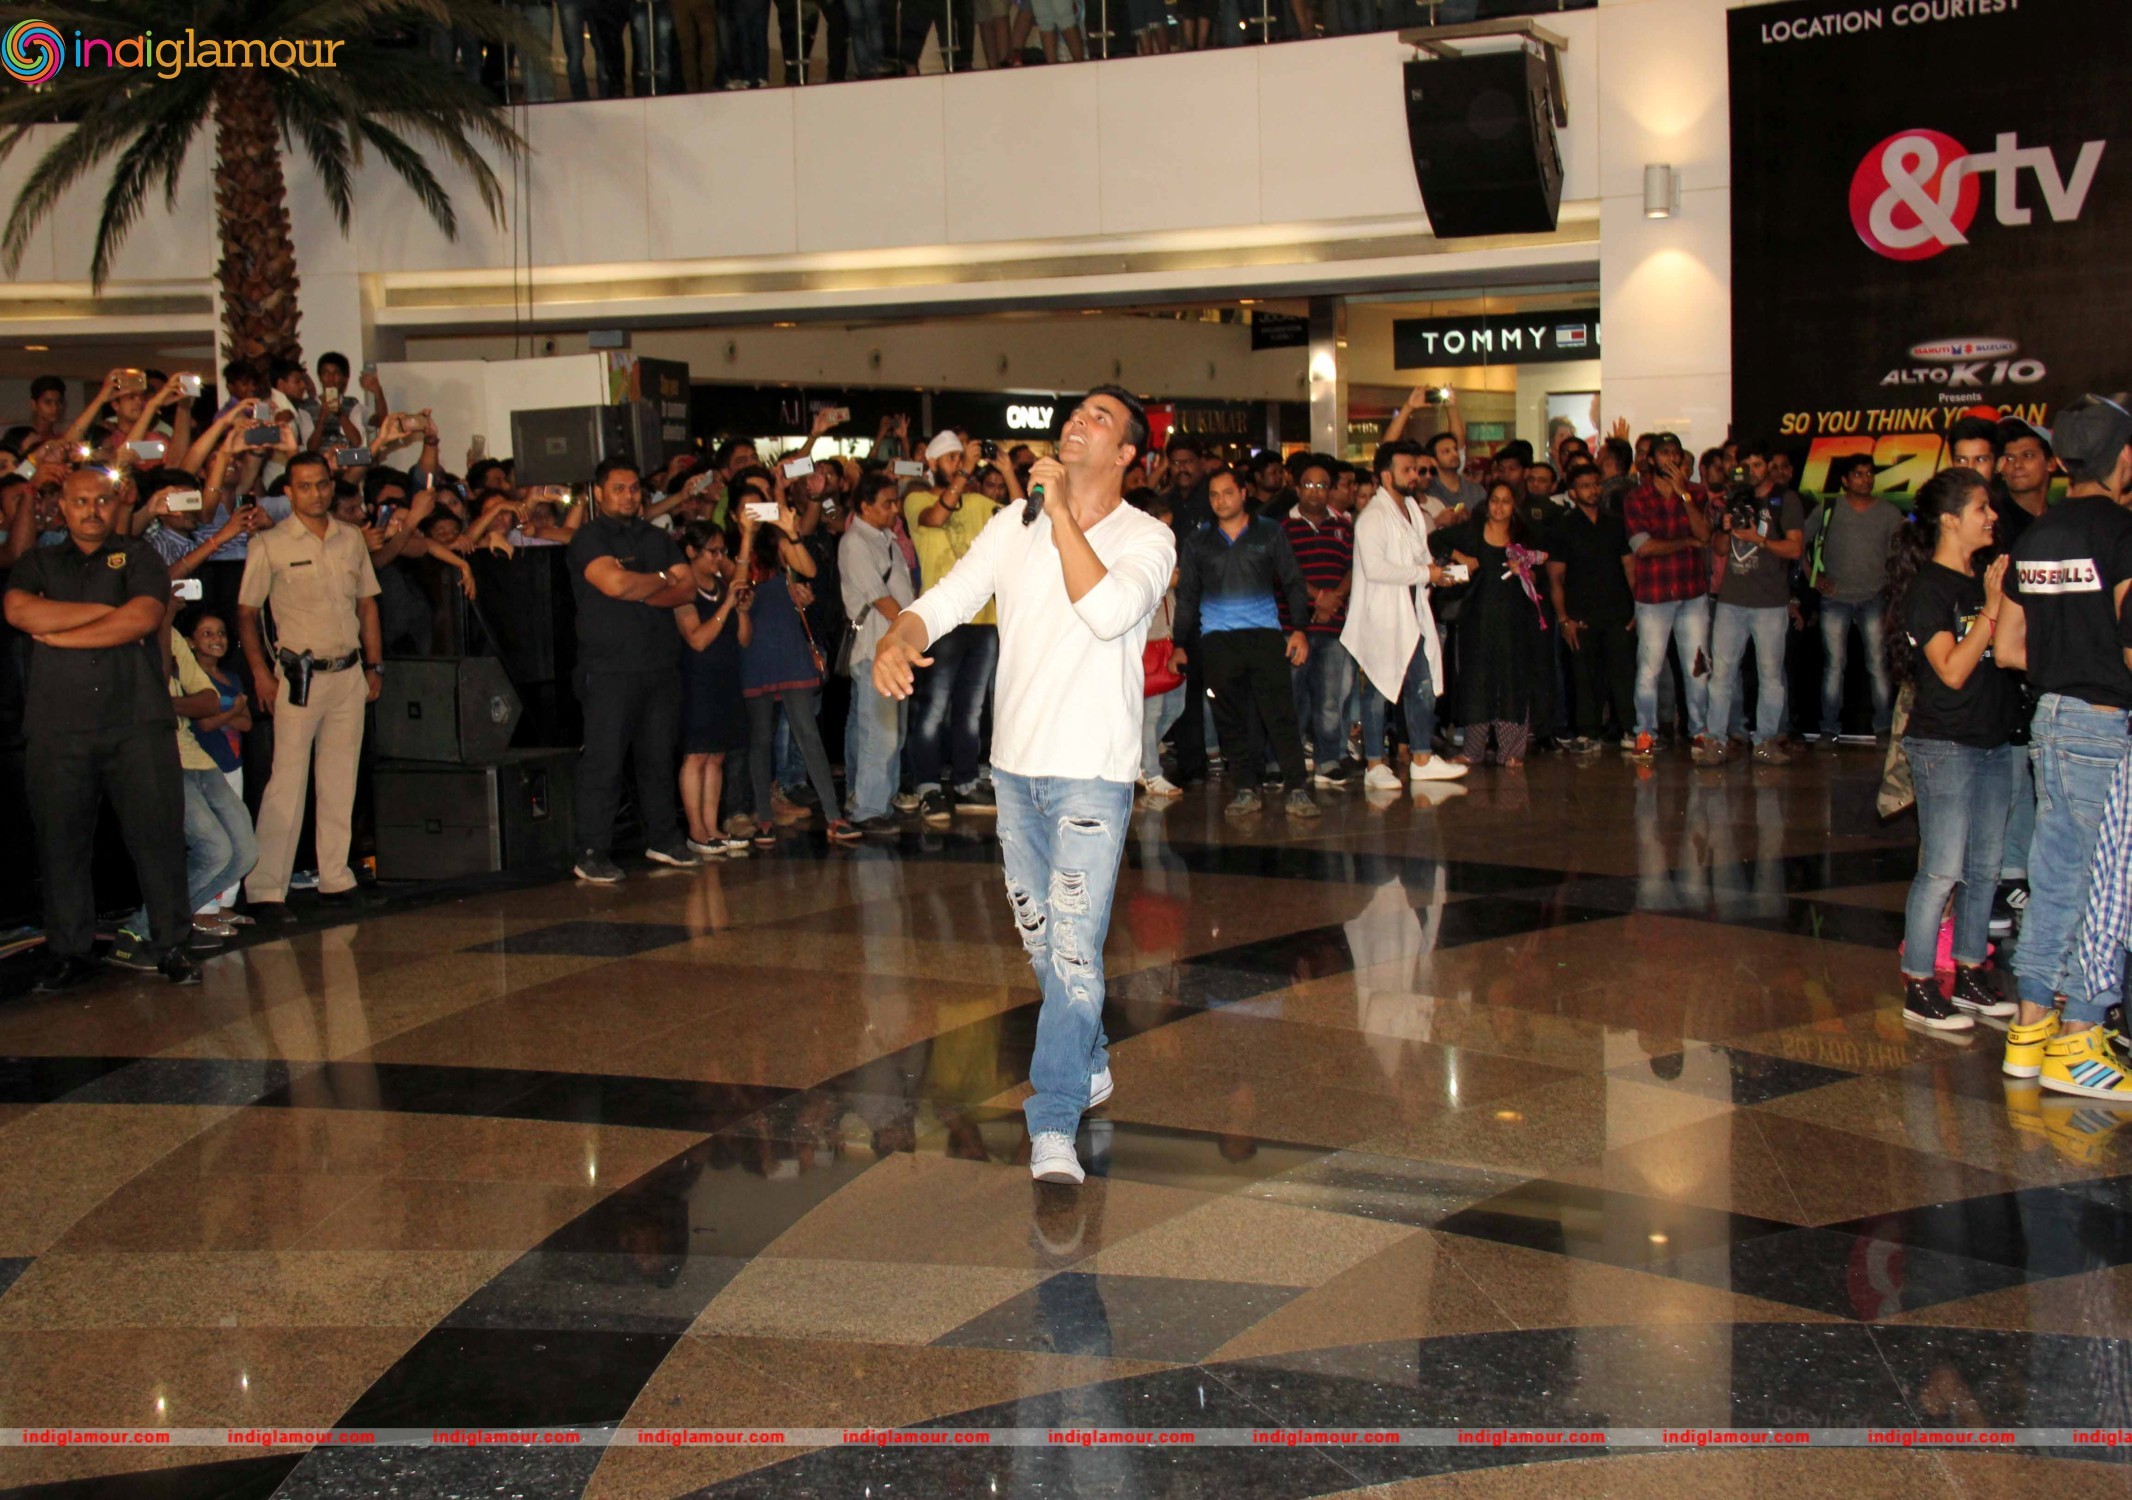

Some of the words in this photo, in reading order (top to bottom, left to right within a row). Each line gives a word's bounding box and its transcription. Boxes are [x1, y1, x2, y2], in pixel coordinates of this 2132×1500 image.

[1761, 8, 1883, 43] LOCATION
[1421, 326, 1547, 354] TOMMY
[1879, 367, 1949, 386] ALTO
[1938, 392, 1982, 403] Presents
[1006, 405, 1054, 429] ONLY
[1780, 412, 1811, 434] SO
[1817, 410, 1861, 434] YOU
[1866, 407, 1938, 431] THINK
